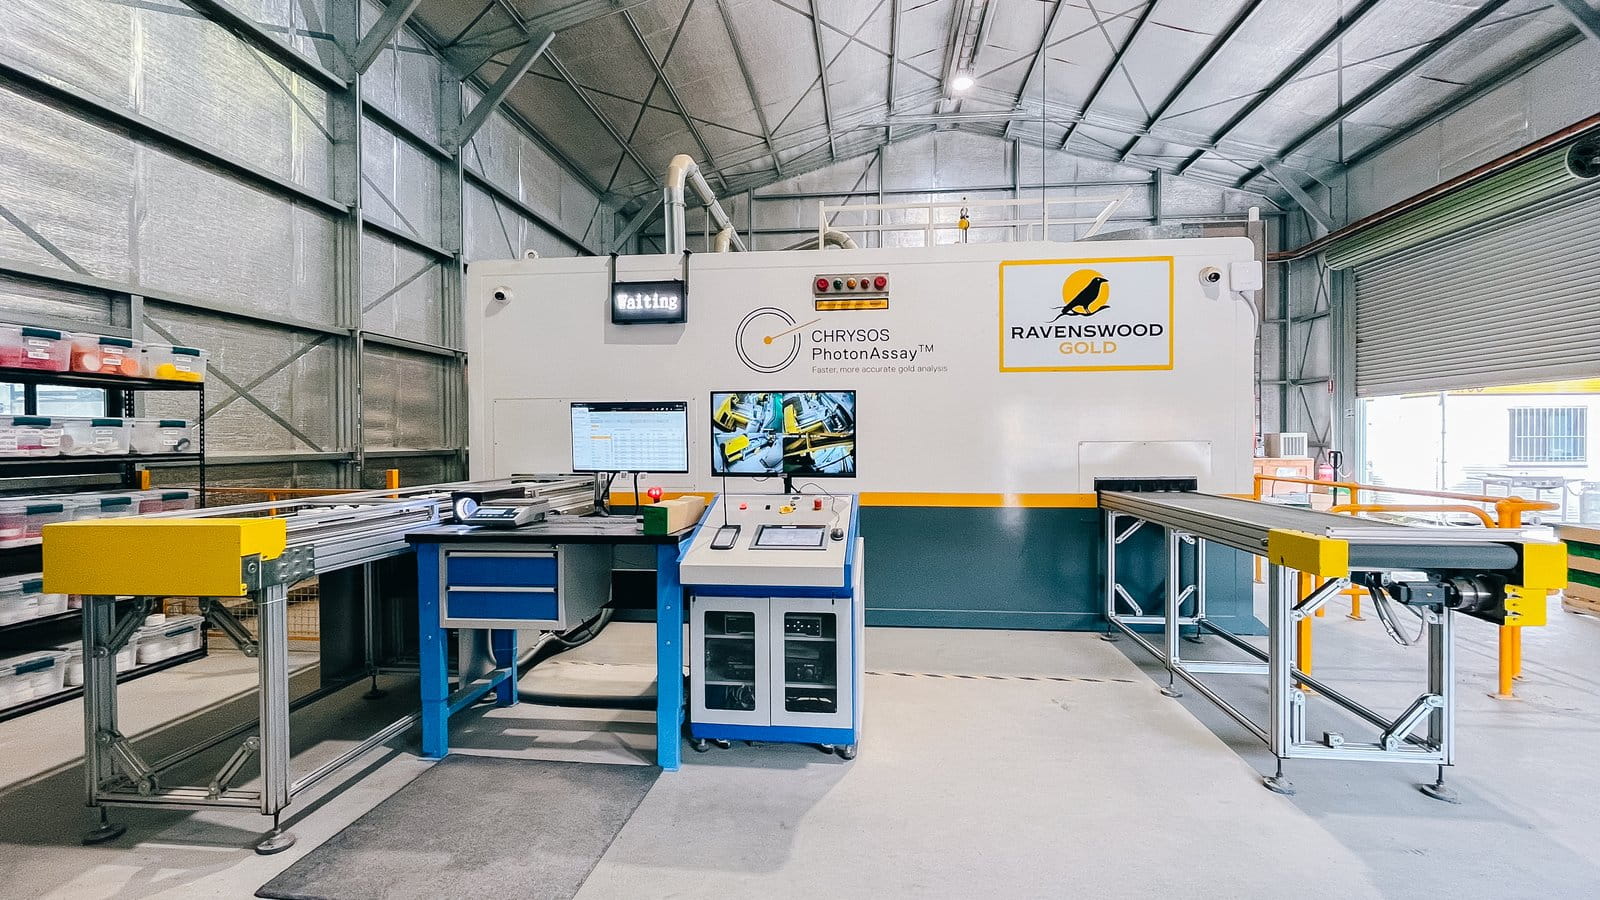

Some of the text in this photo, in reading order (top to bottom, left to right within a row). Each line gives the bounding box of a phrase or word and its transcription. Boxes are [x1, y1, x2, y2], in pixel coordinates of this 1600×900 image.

[616, 293, 678, 310] Waiting
[811, 328, 890, 343] CHRYSOS
[1011, 323, 1164, 339] RAVENSWOOD
[1059, 341, 1117, 354] GOLD
[811, 366, 838, 374] Faster,
[899, 365, 916, 375] gold
[917, 364, 948, 374] analysis
